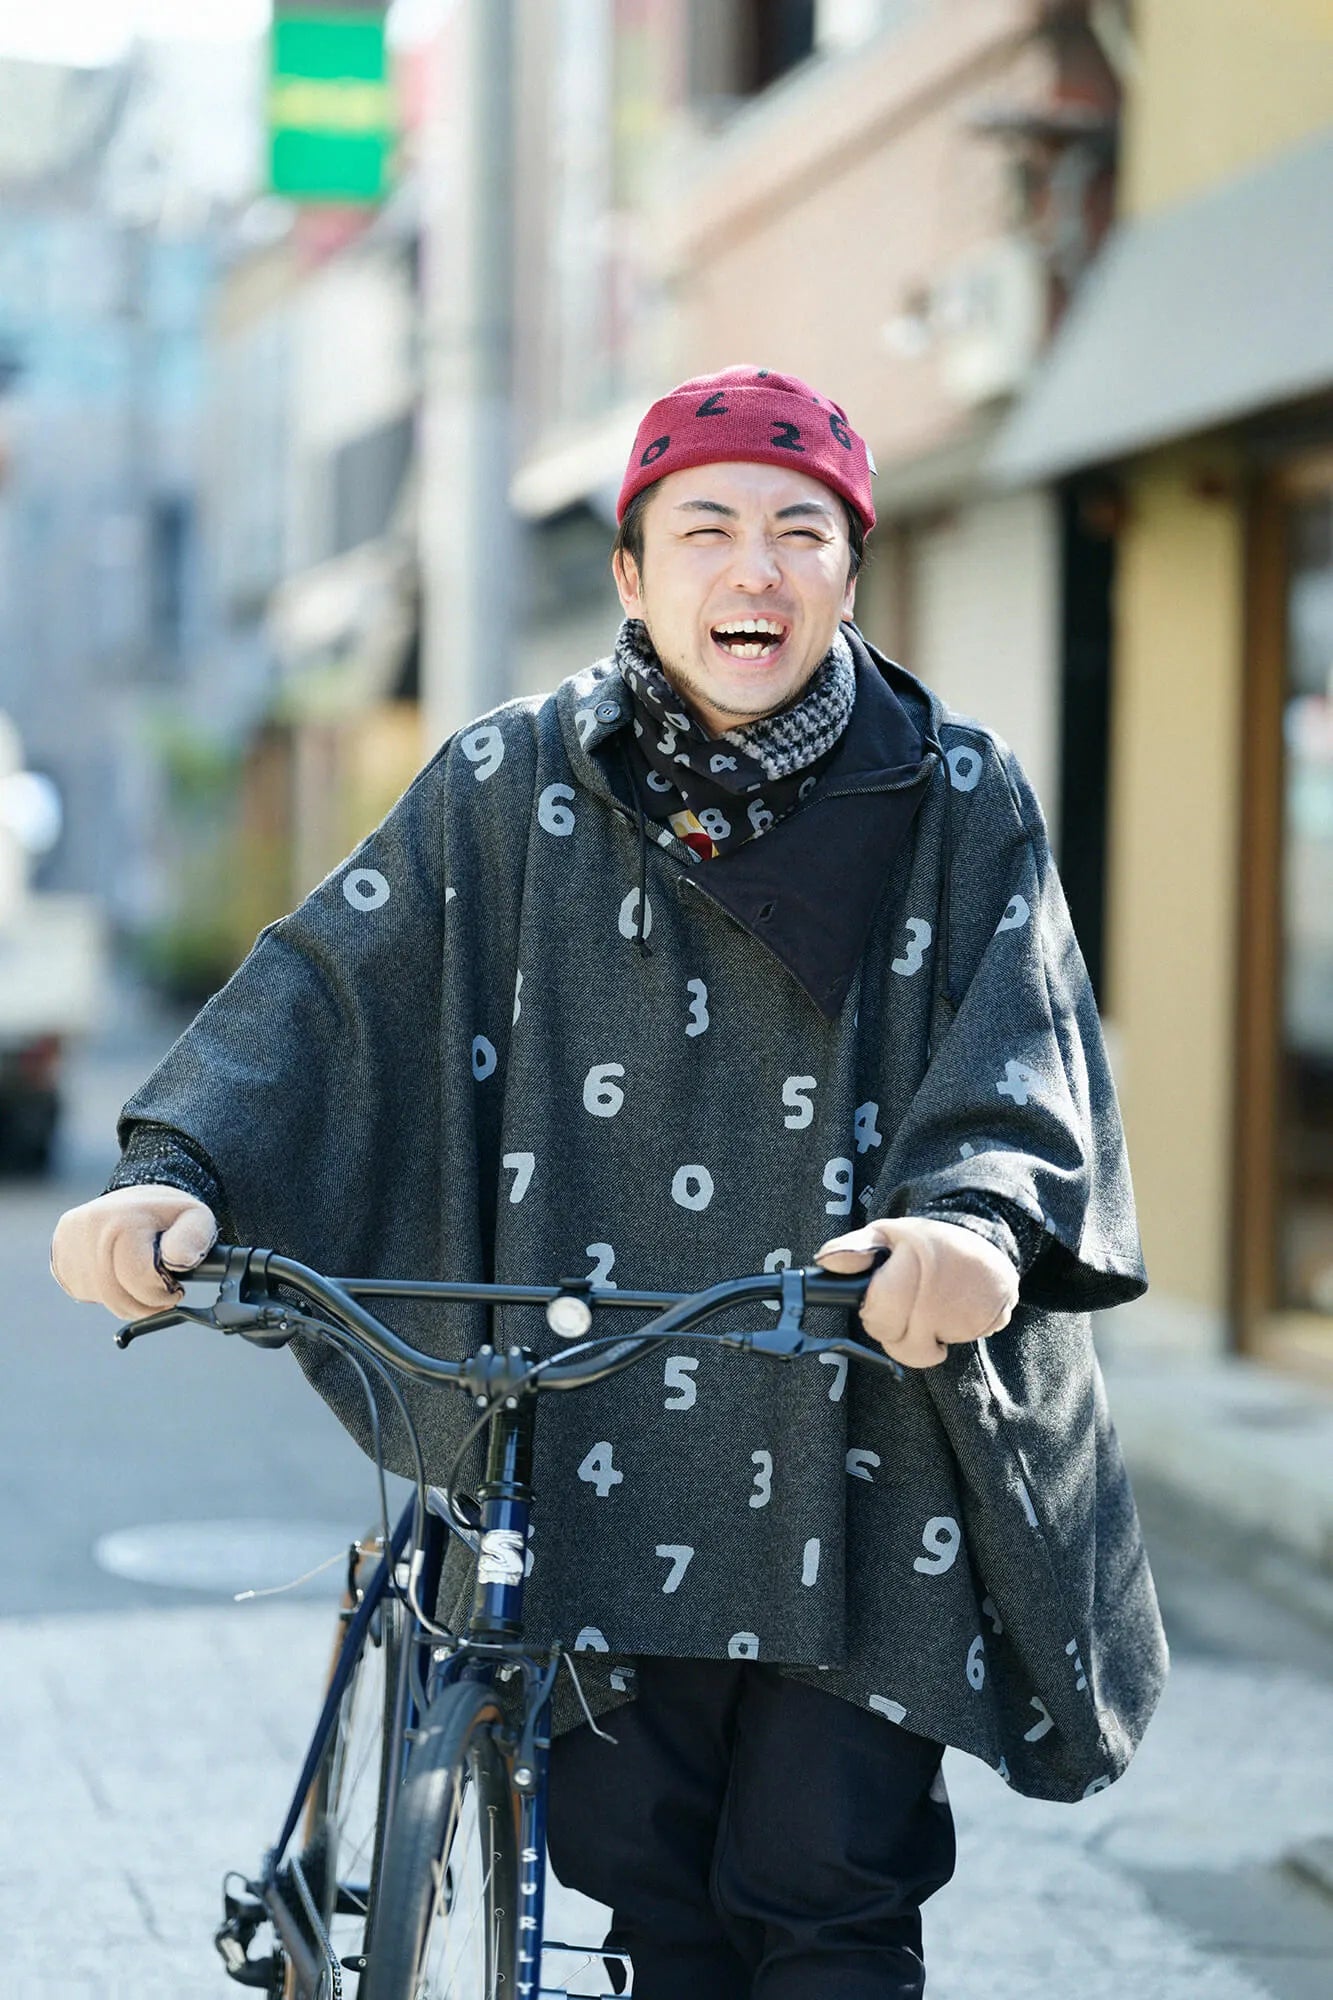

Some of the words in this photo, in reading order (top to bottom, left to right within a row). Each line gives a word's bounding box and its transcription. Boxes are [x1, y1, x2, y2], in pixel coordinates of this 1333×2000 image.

[770, 421, 805, 451] 2
[461, 726, 505, 781] 9
[709, 754, 738, 773] 4
[941, 746, 983, 792] 0
[538, 783, 576, 836] 6
[699, 808, 731, 841] 8
[342, 868, 390, 911] 0
[891, 917, 932, 976] 3
[685, 978, 709, 1037] 3
[472, 1034, 498, 1082] 0
[996, 1059, 1043, 1105] 4
[583, 1062, 625, 1118] 6
[782, 1075, 817, 1129] 5
[854, 1101, 882, 1154] 4
[502, 1152, 536, 1203] 7
[671, 1164, 714, 1211] 0
[822, 1157, 853, 1215] 9
[585, 1242, 617, 1289] 2
[664, 1356, 699, 1410] 5
[819, 1352, 848, 1402] 7
[577, 1441, 623, 1497] 4
[749, 1450, 773, 1509] 3
[655, 1544, 695, 1594] 7
[801, 1537, 821, 1587] 1
[913, 1516, 961, 1576] 9
[966, 1634, 985, 1691] 6
[516, 1847, 539, 1996] SURLY
